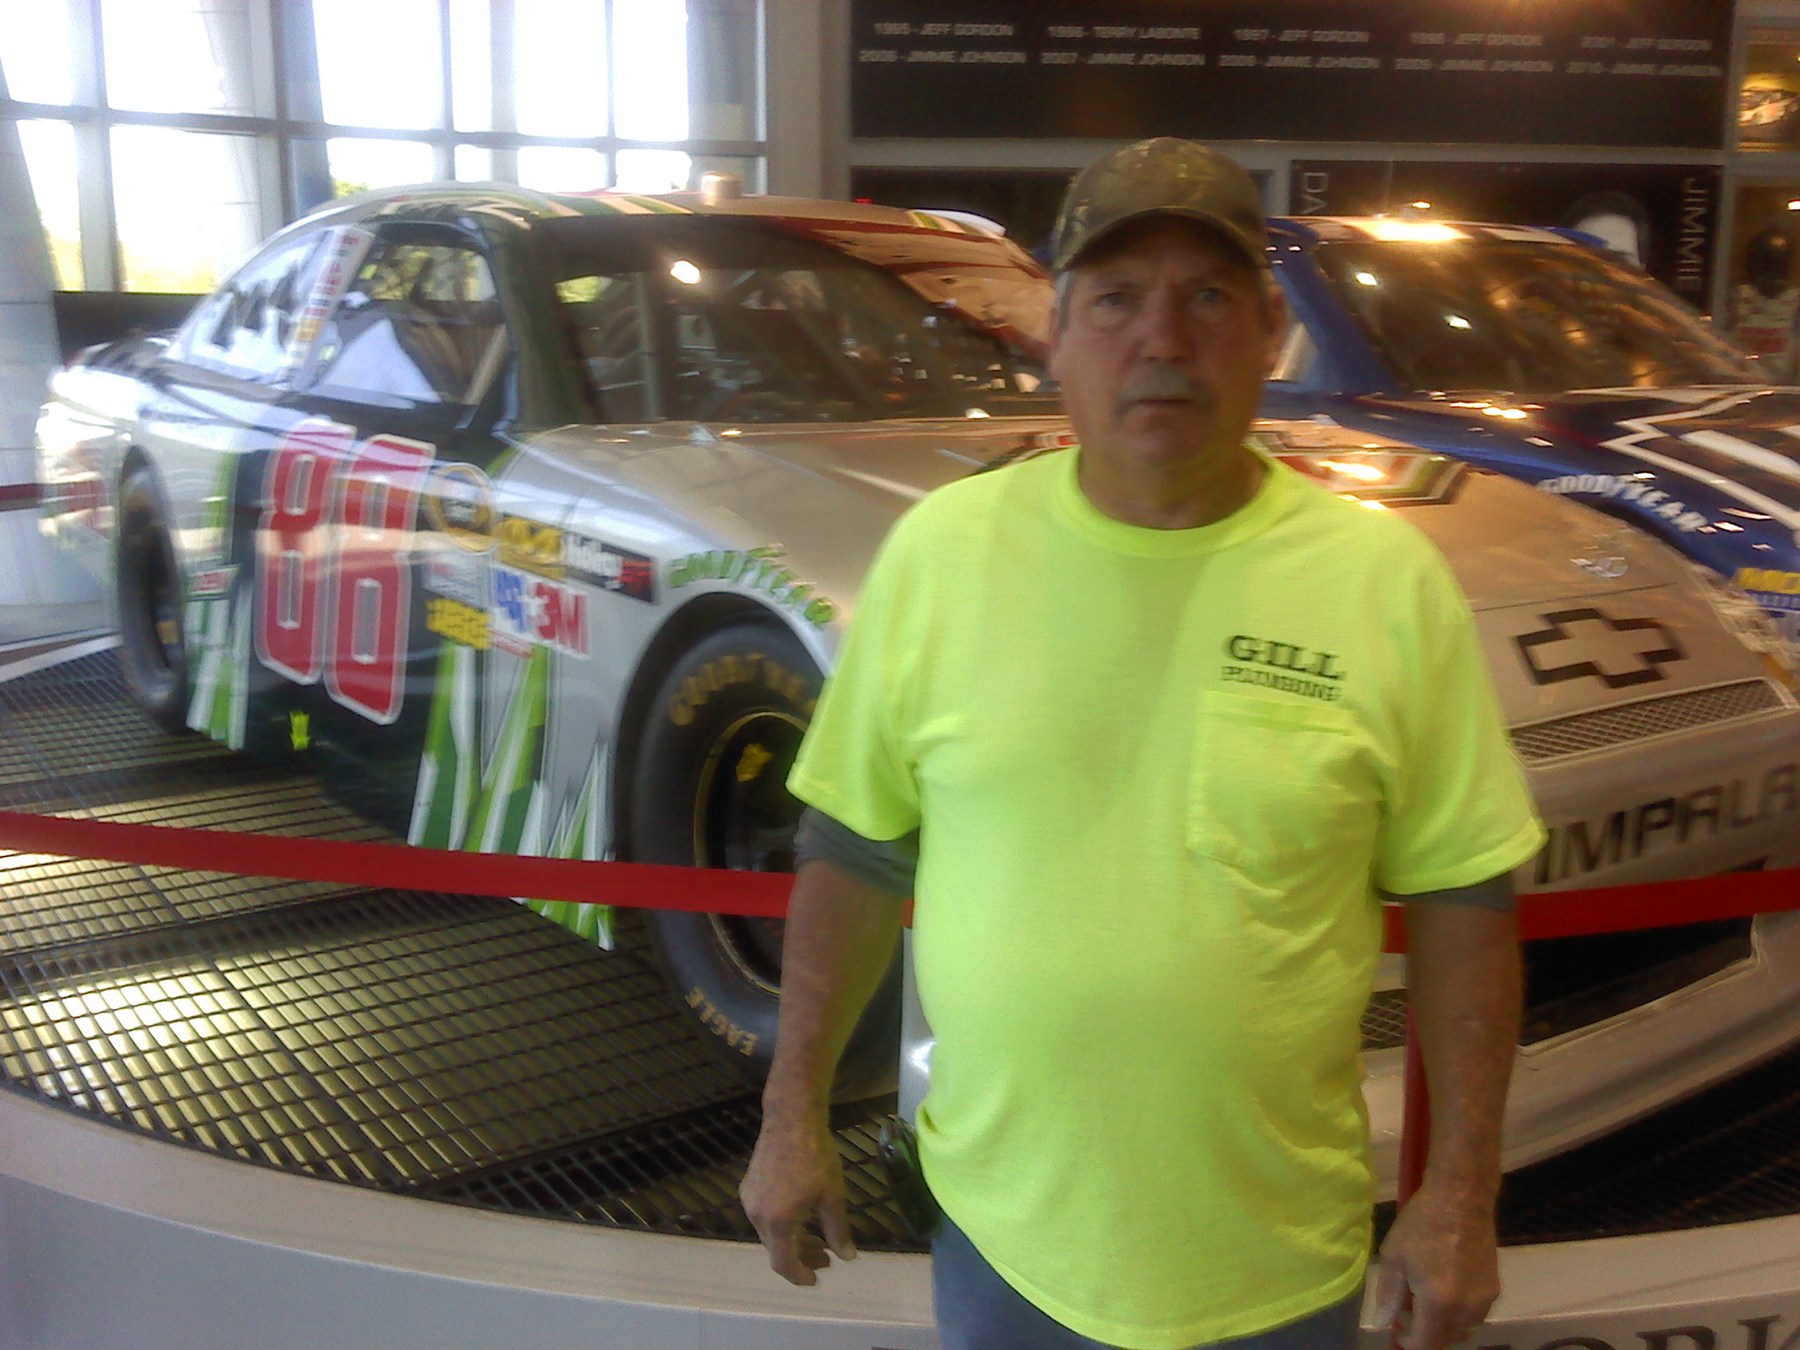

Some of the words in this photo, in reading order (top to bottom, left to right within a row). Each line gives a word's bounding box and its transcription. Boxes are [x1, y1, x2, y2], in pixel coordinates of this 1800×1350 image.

[1302, 172, 1328, 214] DA
[1223, 634, 1347, 680] GILL
[1535, 763, 1800, 884] IMPALA
[685, 986, 759, 1057] EAGLE
